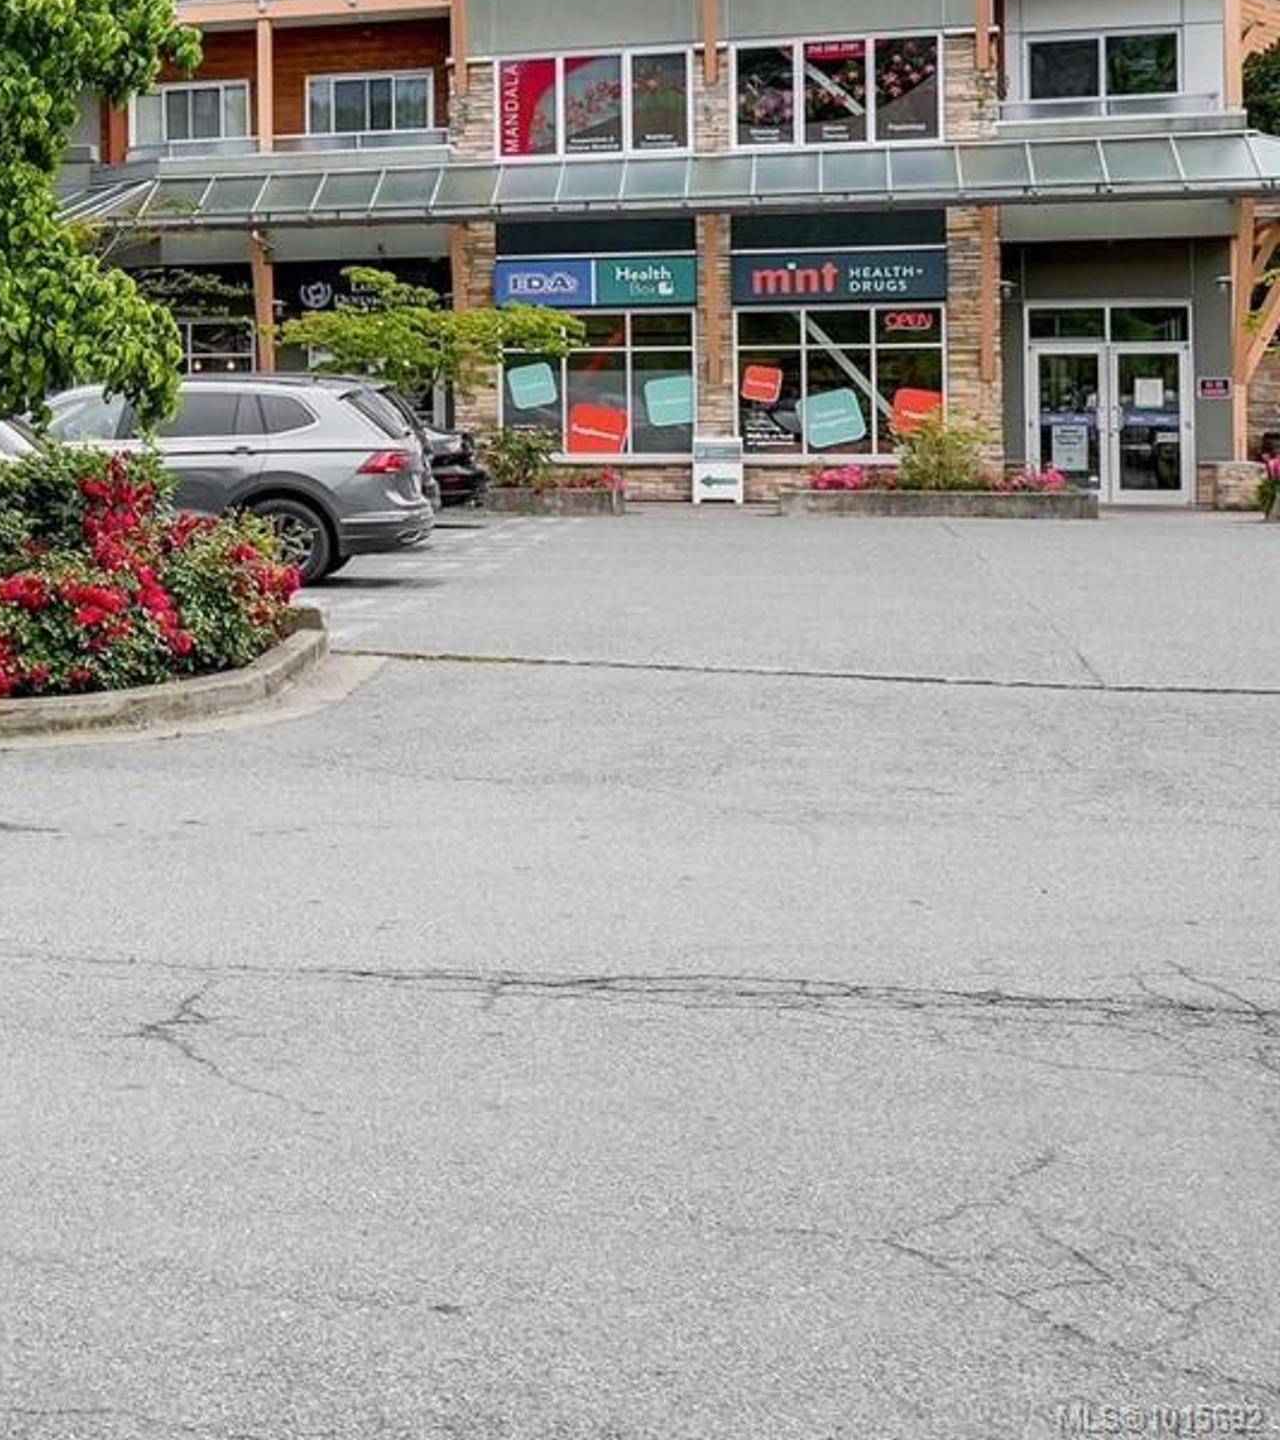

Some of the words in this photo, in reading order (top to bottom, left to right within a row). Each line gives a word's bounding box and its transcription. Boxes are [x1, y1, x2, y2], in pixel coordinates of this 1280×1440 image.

[503, 63, 521, 153] MANDALA
[614, 265, 672, 281] Health
[751, 262, 838, 294] mint
[848, 280, 908, 292] DRUGS
[884, 312, 935, 331] OPEN
